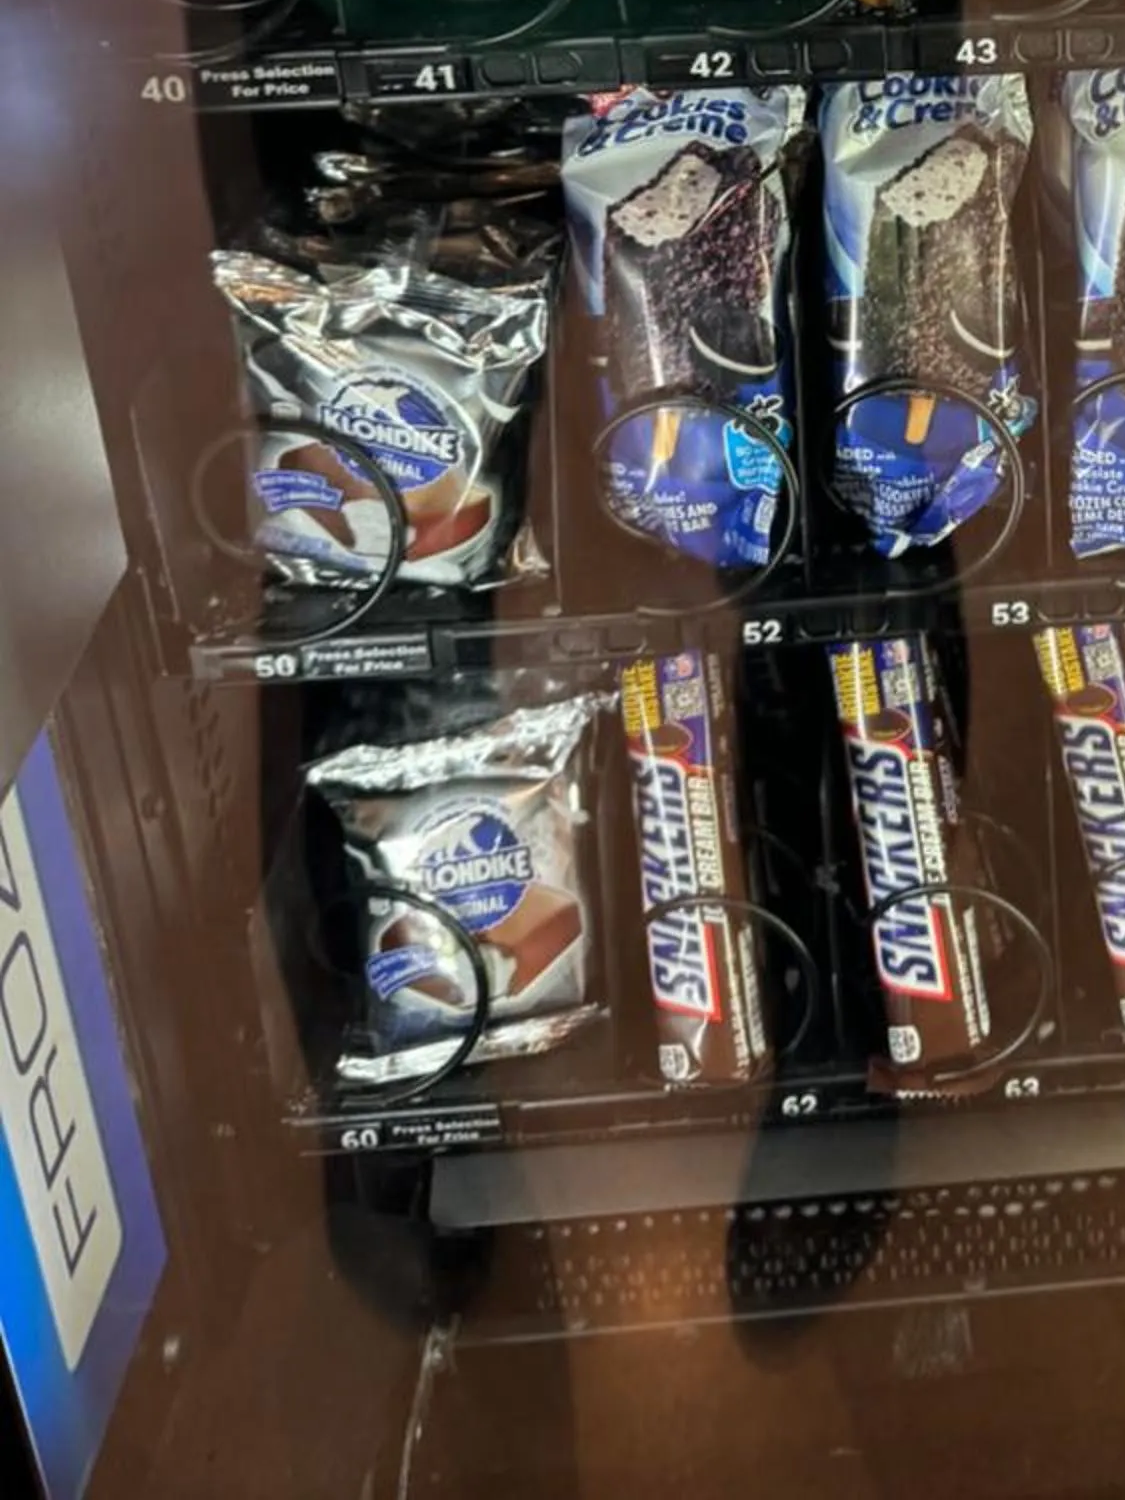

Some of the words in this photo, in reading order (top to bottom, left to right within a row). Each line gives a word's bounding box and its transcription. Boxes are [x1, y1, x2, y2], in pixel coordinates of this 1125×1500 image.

[689, 52, 734, 78] 42
[955, 38, 998, 64] 43
[141, 75, 187, 103] 40
[201, 68, 250, 83] Press
[253, 63, 335, 80] Selection
[231, 85, 262, 98] For
[265, 82, 310, 96] Price
[414, 64, 457, 91] 41
[852, 104, 883, 134] &
[1094, 101, 1120, 137] &
[321, 406, 458, 463] KLONDIKE
[991, 602, 1029, 625] 53
[743, 621, 783, 645] 52
[254, 653, 297, 678] 50
[307, 650, 351, 663] Press
[353, 645, 427, 660] Selection
[363, 660, 404, 672] Price
[688, 776, 712, 815] BAR
[697, 817, 723, 887] CREAM
[848, 741, 940, 987] SNICKERS
[426, 850, 531, 891] LONDIKE
[632, 756, 709, 1009] SNICKERS
[1004, 1077, 1040, 1099] 63
[781, 1095, 819, 1117] 62
[340, 1129, 379, 1150] 60
[392, 1124, 432, 1136] Press
[434, 1118, 500, 1132] Selection
[443, 1131, 480, 1143] Price
